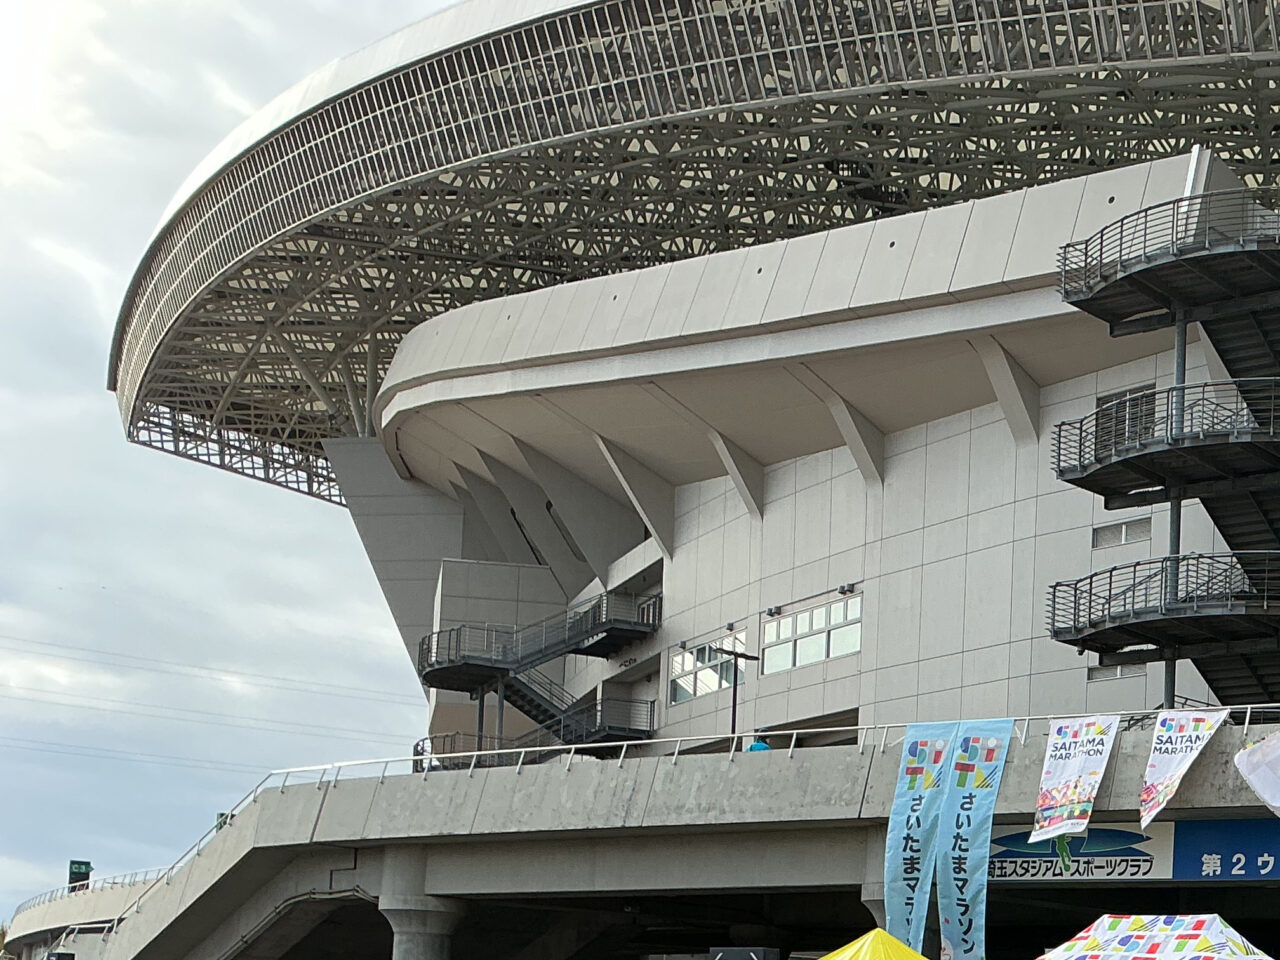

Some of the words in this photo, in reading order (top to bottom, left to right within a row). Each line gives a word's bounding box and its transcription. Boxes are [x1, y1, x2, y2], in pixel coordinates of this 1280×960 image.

[1051, 738, 1105, 753] SAITAMA
[1048, 748, 1104, 761] MARATHON
[951, 792, 977, 954] さいたまマラソン
